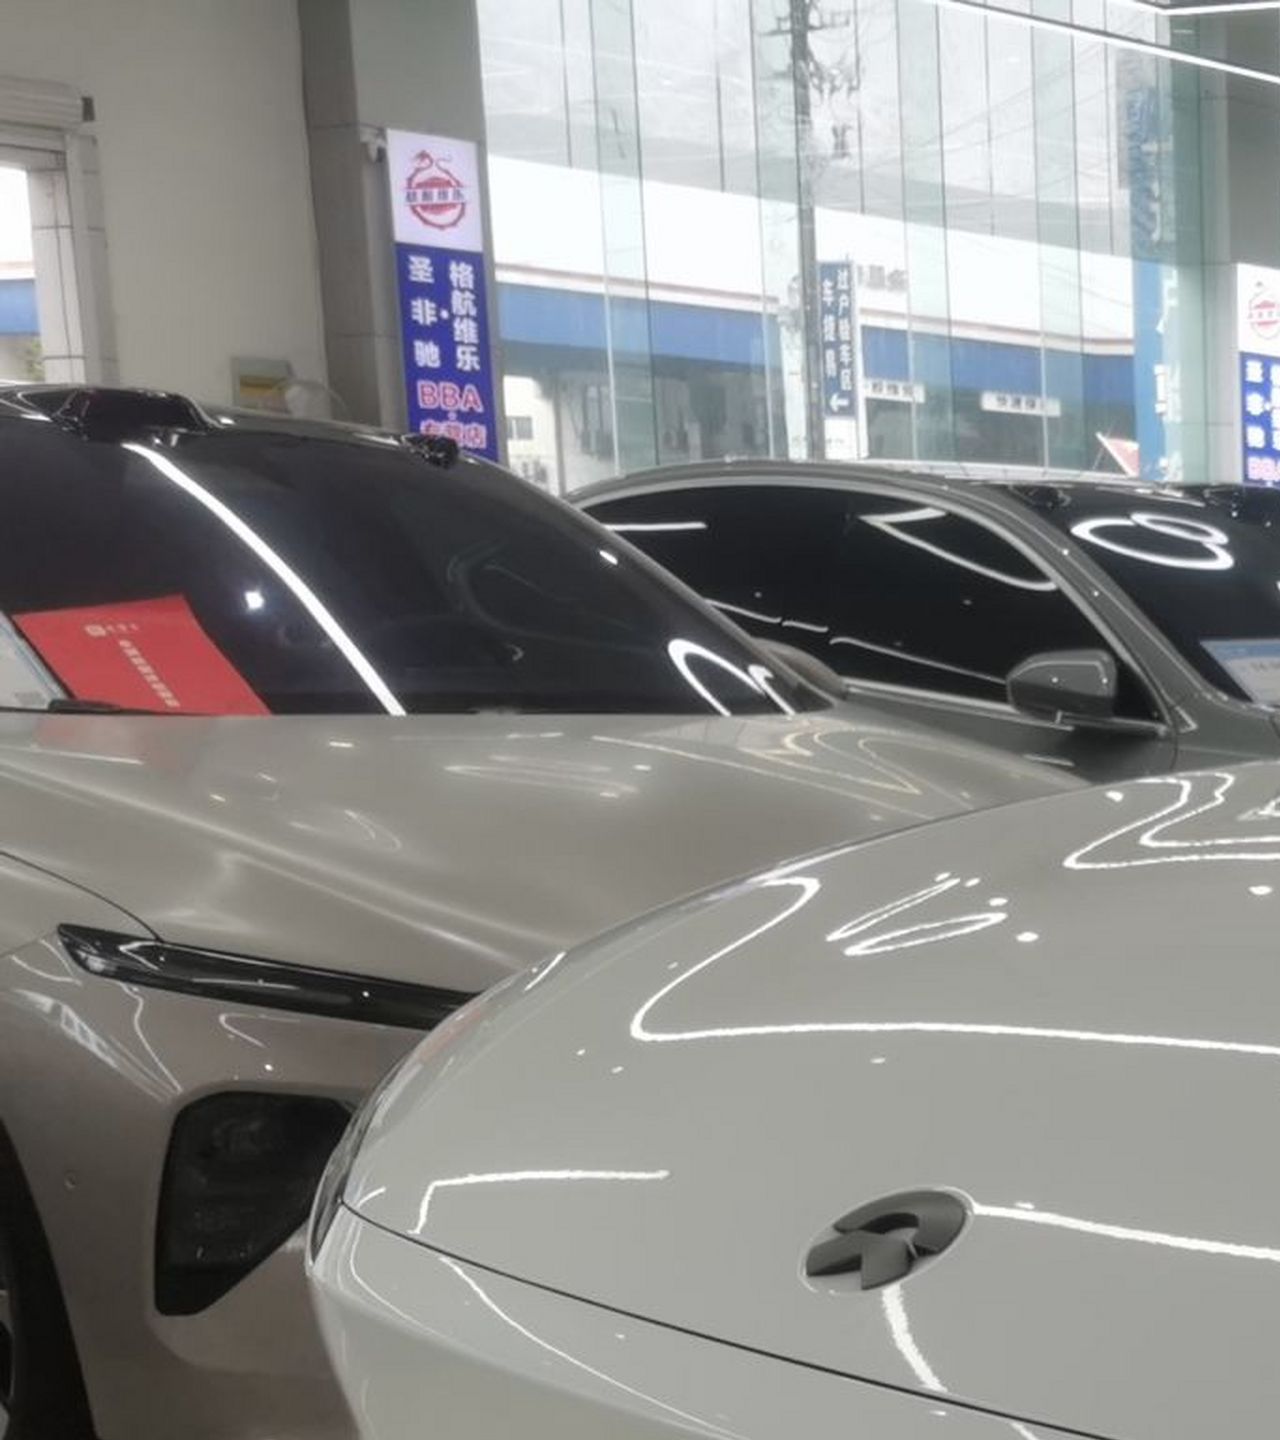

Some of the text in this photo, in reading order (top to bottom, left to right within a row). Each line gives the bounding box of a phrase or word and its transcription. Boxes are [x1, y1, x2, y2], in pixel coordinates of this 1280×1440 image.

[408, 255, 441, 369] 圣非驰
[449, 261, 481, 372] 格航维乐
[417, 380, 484, 412] BBA
